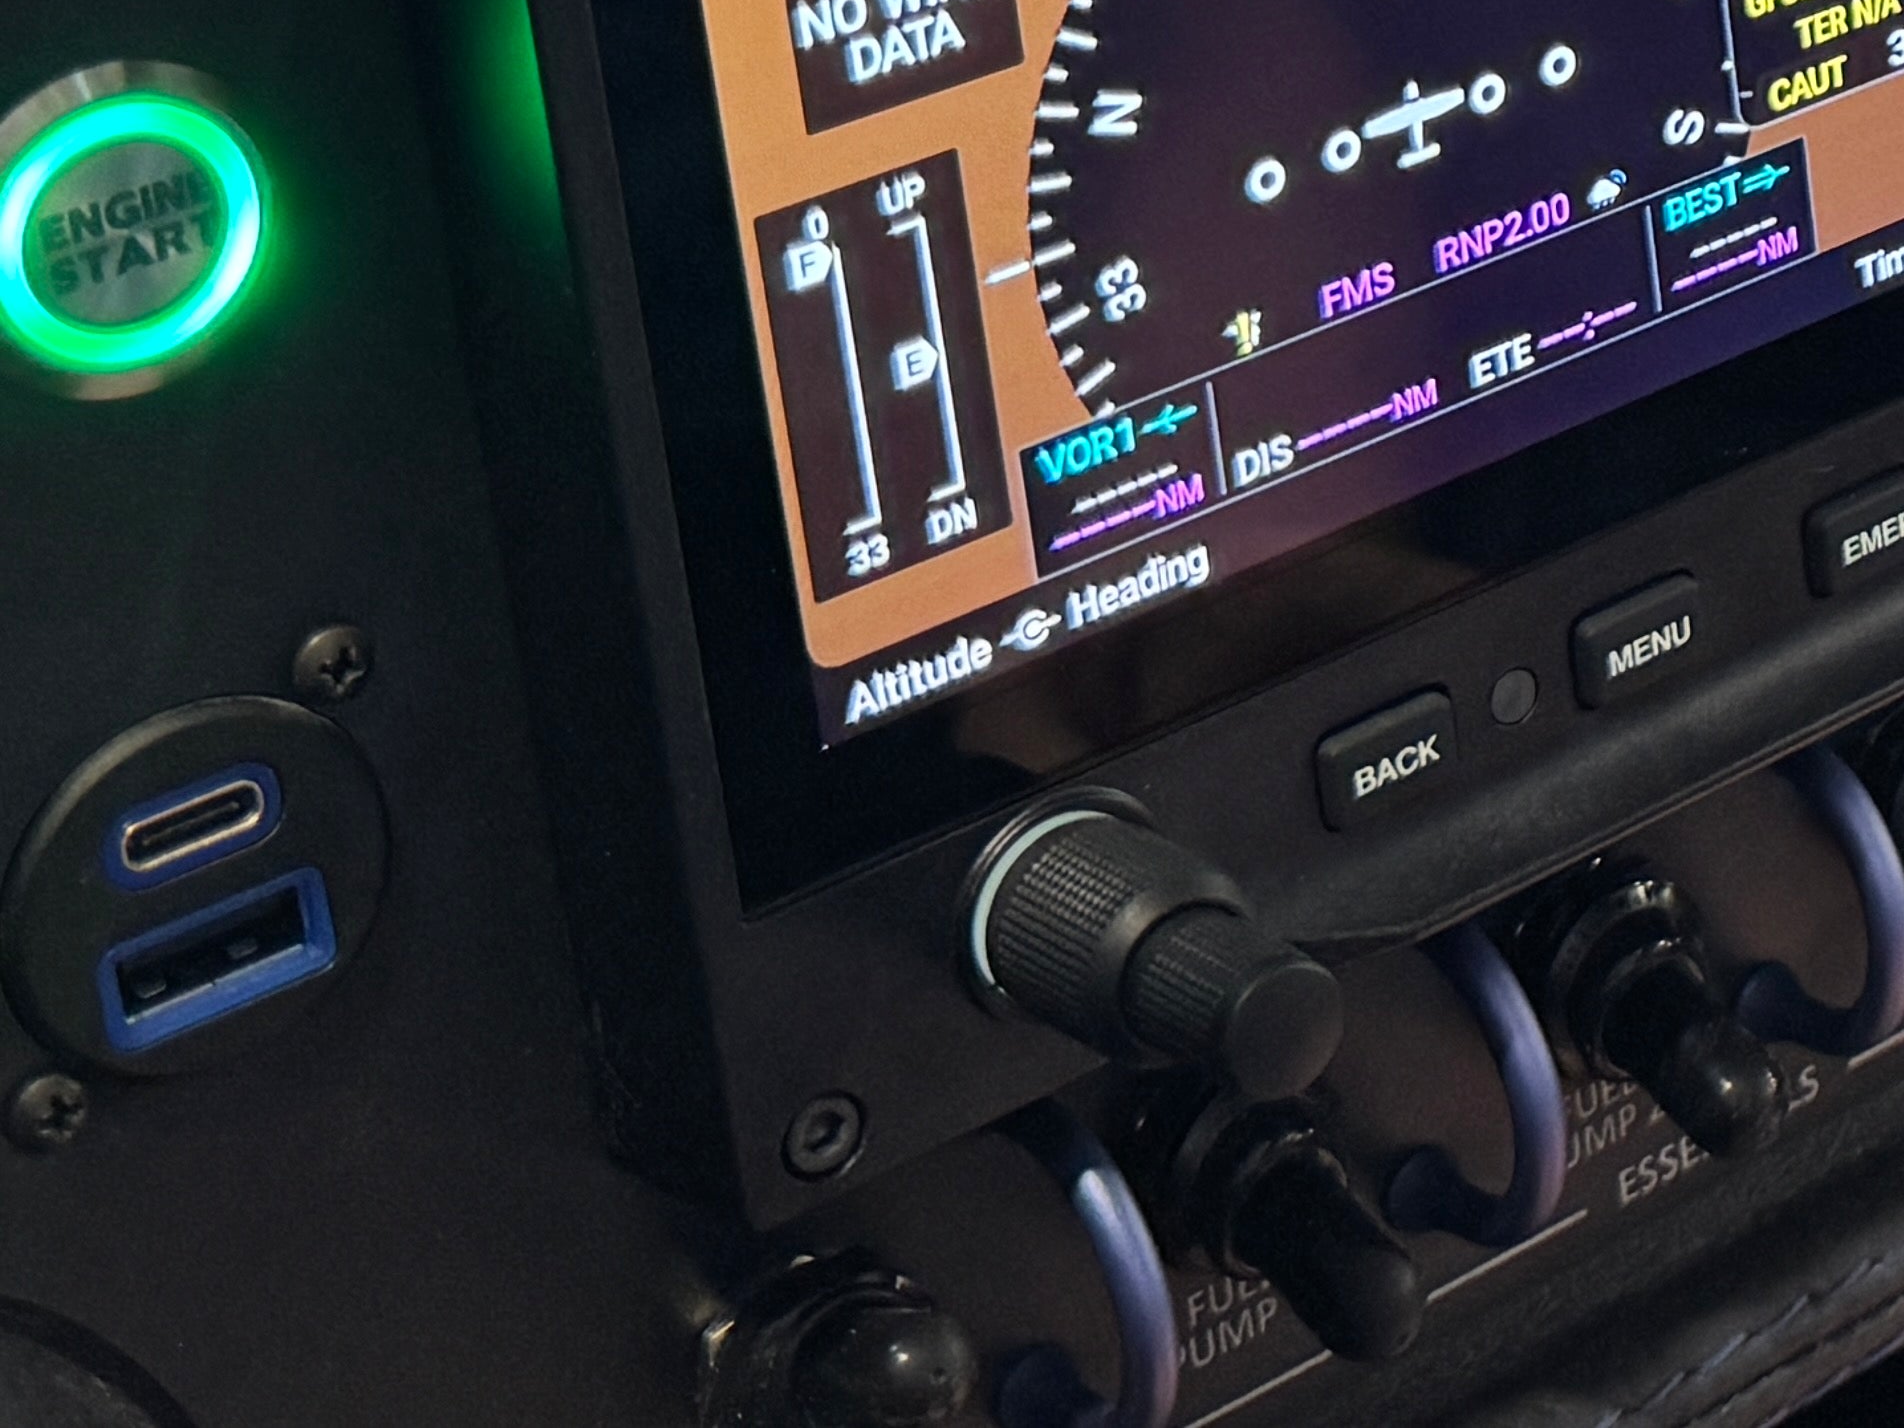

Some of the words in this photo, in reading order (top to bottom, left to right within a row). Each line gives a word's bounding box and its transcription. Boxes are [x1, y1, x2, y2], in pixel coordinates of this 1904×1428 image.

[846, 9, 966, 83] DATA
[1794, 6, 1848, 49] TER
[1768, 55, 1847, 112] CAUT
[39, 170, 214, 249] ENGINE
[877, 171, 925, 217] UP
[1664, 172, 1741, 231] BEST
[47, 213, 215, 296] START
[1319, 262, 1396, 320] FMS
[1432, 193, 1571, 274] RNP2.00
[1034, 417, 1138, 483] VOR1
[928, 497, 977, 545] DN
[844, 635, 993, 726] Altitude
[1066, 544, 1210, 629] Heading
[1606, 616, 1693, 680] MENU
[1352, 736, 1441, 800] BACK
